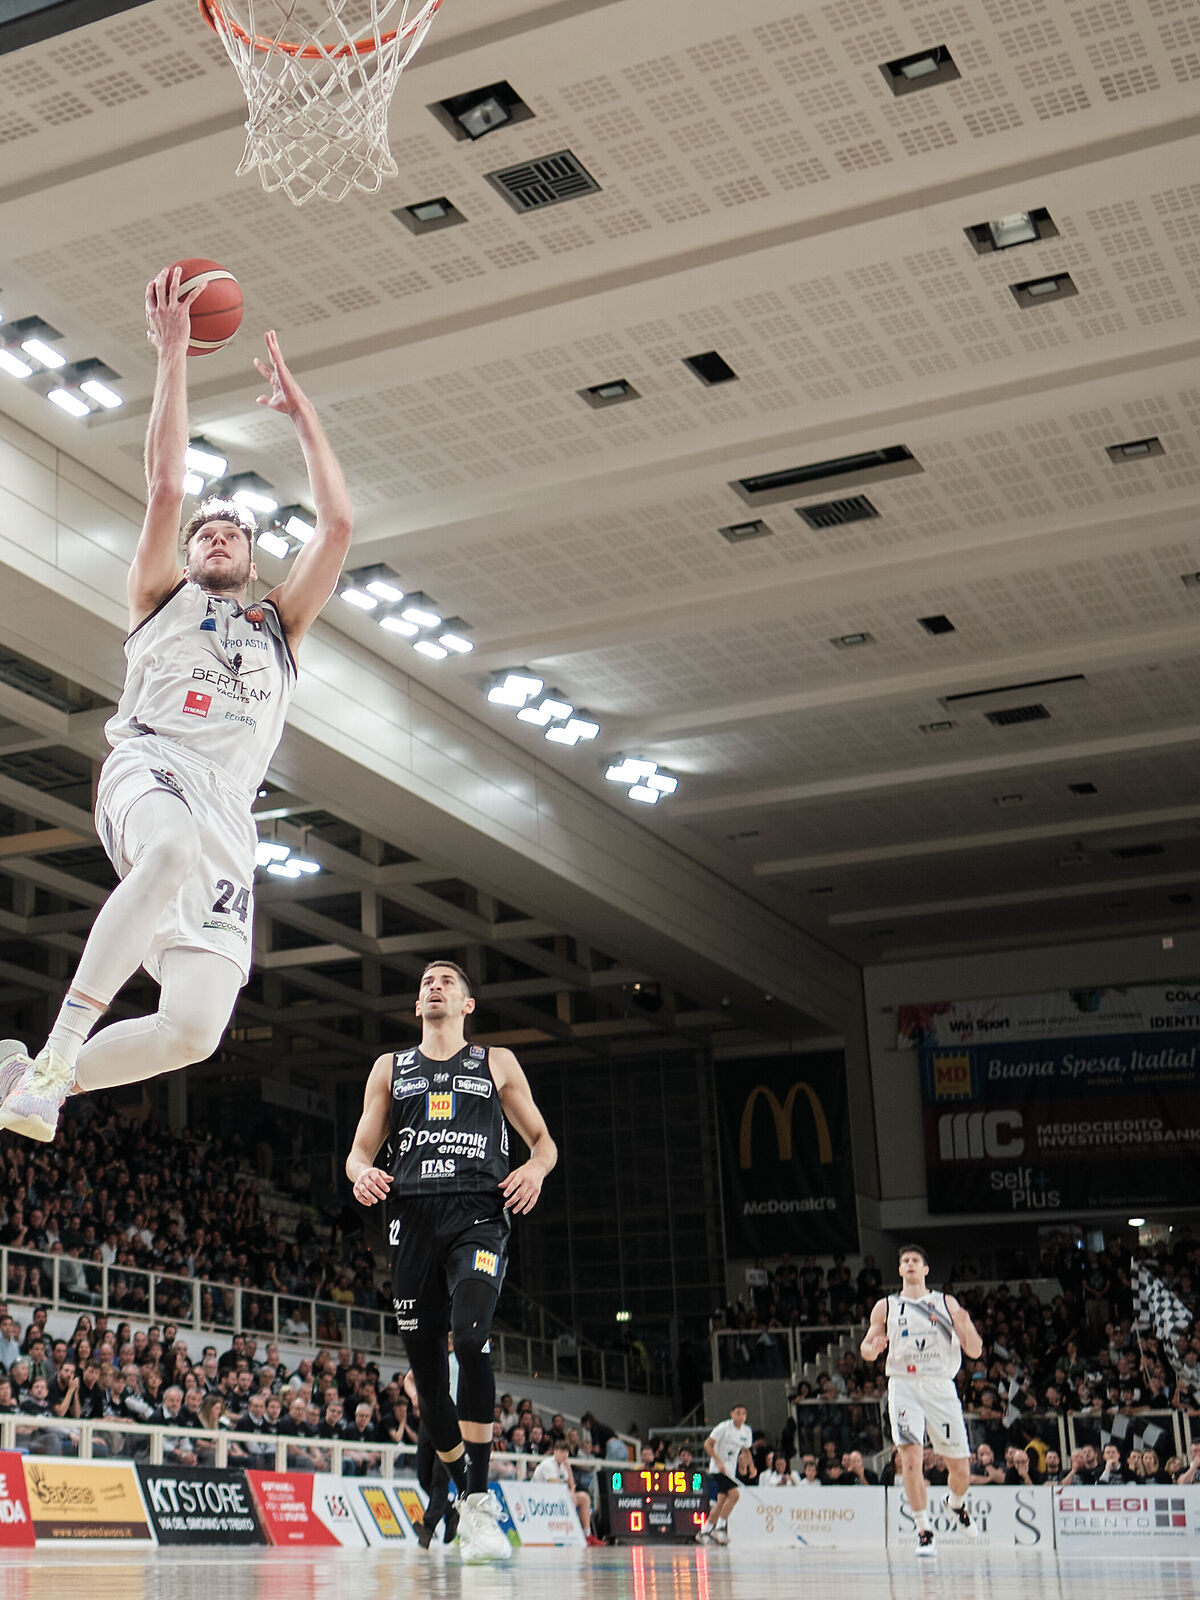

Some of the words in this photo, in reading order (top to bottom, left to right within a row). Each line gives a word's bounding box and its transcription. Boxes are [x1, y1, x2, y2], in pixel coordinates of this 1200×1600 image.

[216, 687, 250, 703] YACHTS
[212, 879, 250, 923] 24
[950, 1021, 973, 1032] Win
[976, 1018, 1010, 1030] Sport
[395, 1051, 416, 1066] 12
[988, 1061, 1054, 1079] Buona
[1060, 1054, 1126, 1078] Spesa,
[1131, 1048, 1196, 1071] Italia!
[937, 1066, 967, 1083] MD
[431, 1100, 450, 1110] MD
[1037, 1118, 1163, 1135] MEDIOCREDITO
[416, 1129, 488, 1149] Dolomiti
[437, 1145, 485, 1159] energia
[421, 1159, 456, 1174] ITAS
[991, 1166, 1032, 1190] Self
[743, 1197, 837, 1216] McDonald's
[1012, 1190, 1061, 1209] Plus
[389, 1219, 401, 1246] 12
[478, 1256, 494, 1267] MD
[898, 1302, 905, 1315] 7
[942, 1423, 950, 1439] 7
[640, 1471, 687, 1492] 7:15
[37, 1480, 95, 1505] Sapiens
[528, 1497, 569, 1516] Dolomiti
[618, 1498, 643, 1509] HOME
[674, 1498, 701, 1509] GUEST
[1059, 1498, 1148, 1512] ELLEGI
[630, 1511, 643, 1531] 0
[790, 1508, 855, 1521] TRENTINO
[1061, 1516, 1149, 1528] TRENTO
